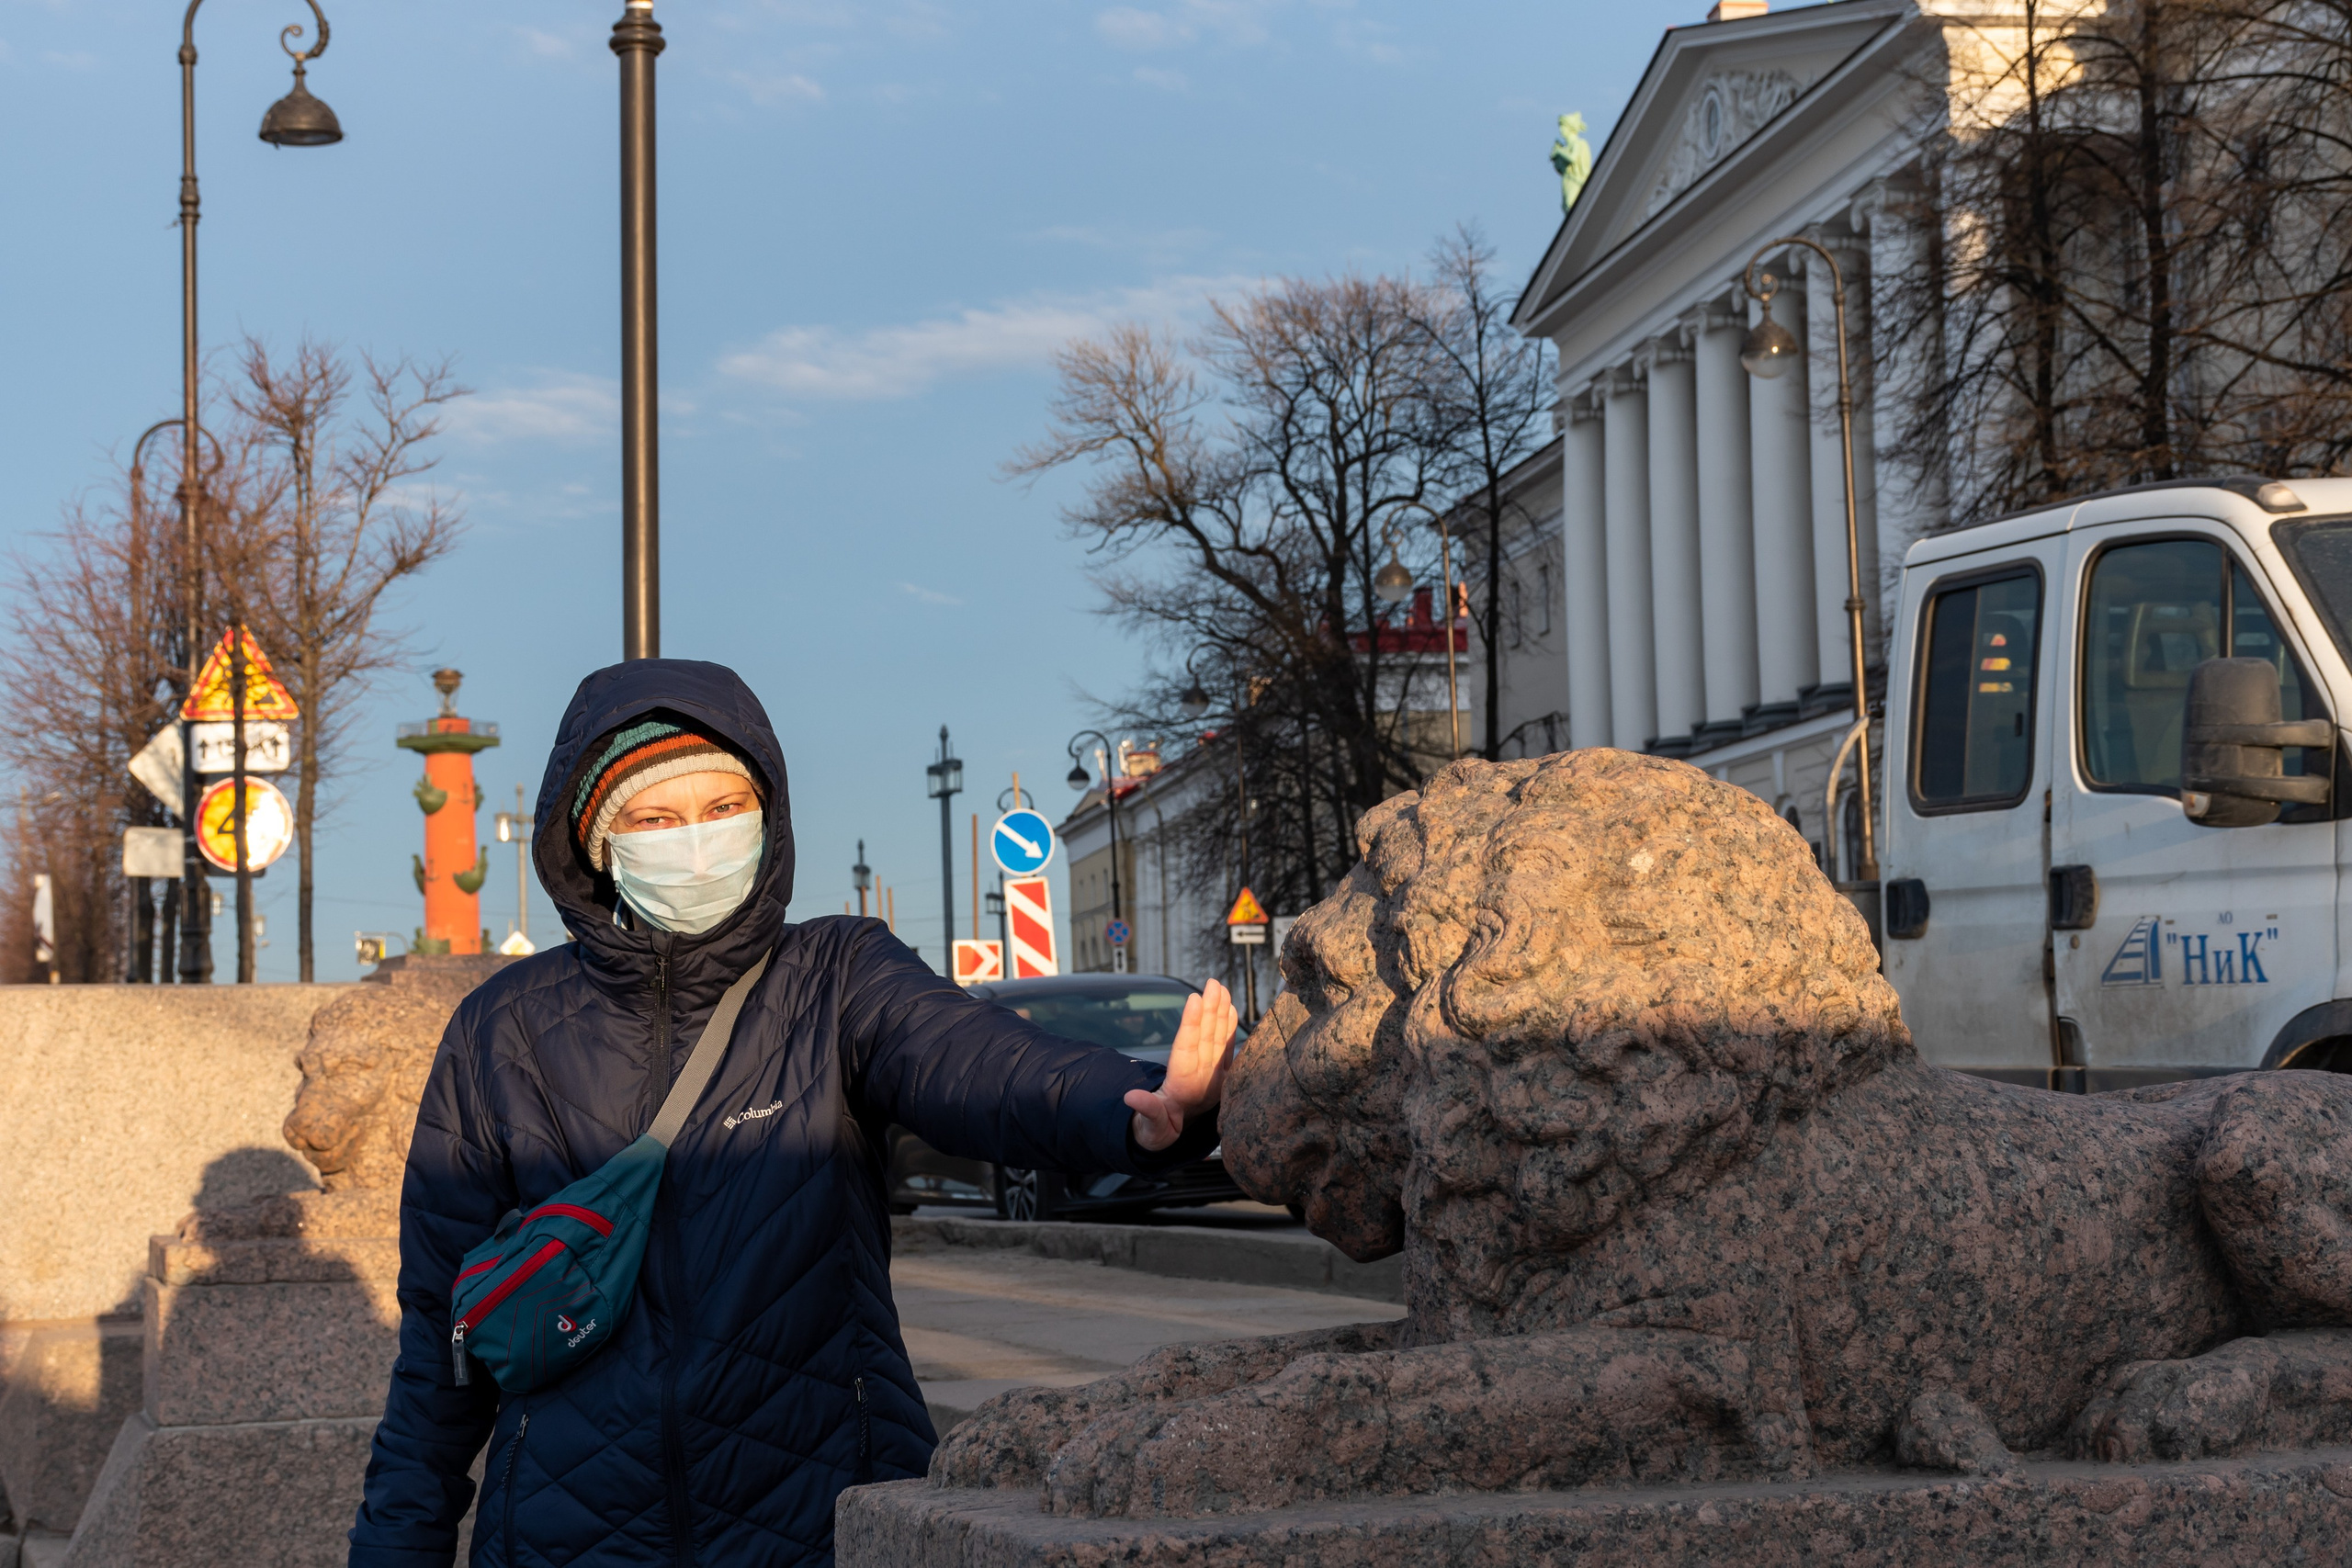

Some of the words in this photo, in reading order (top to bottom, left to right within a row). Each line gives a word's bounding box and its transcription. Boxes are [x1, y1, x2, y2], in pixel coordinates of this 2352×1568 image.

[2165, 927, 2278, 986] "НиК"
[737, 1100, 783, 1124] Columbia
[568, 1318, 597, 1348] deuter
